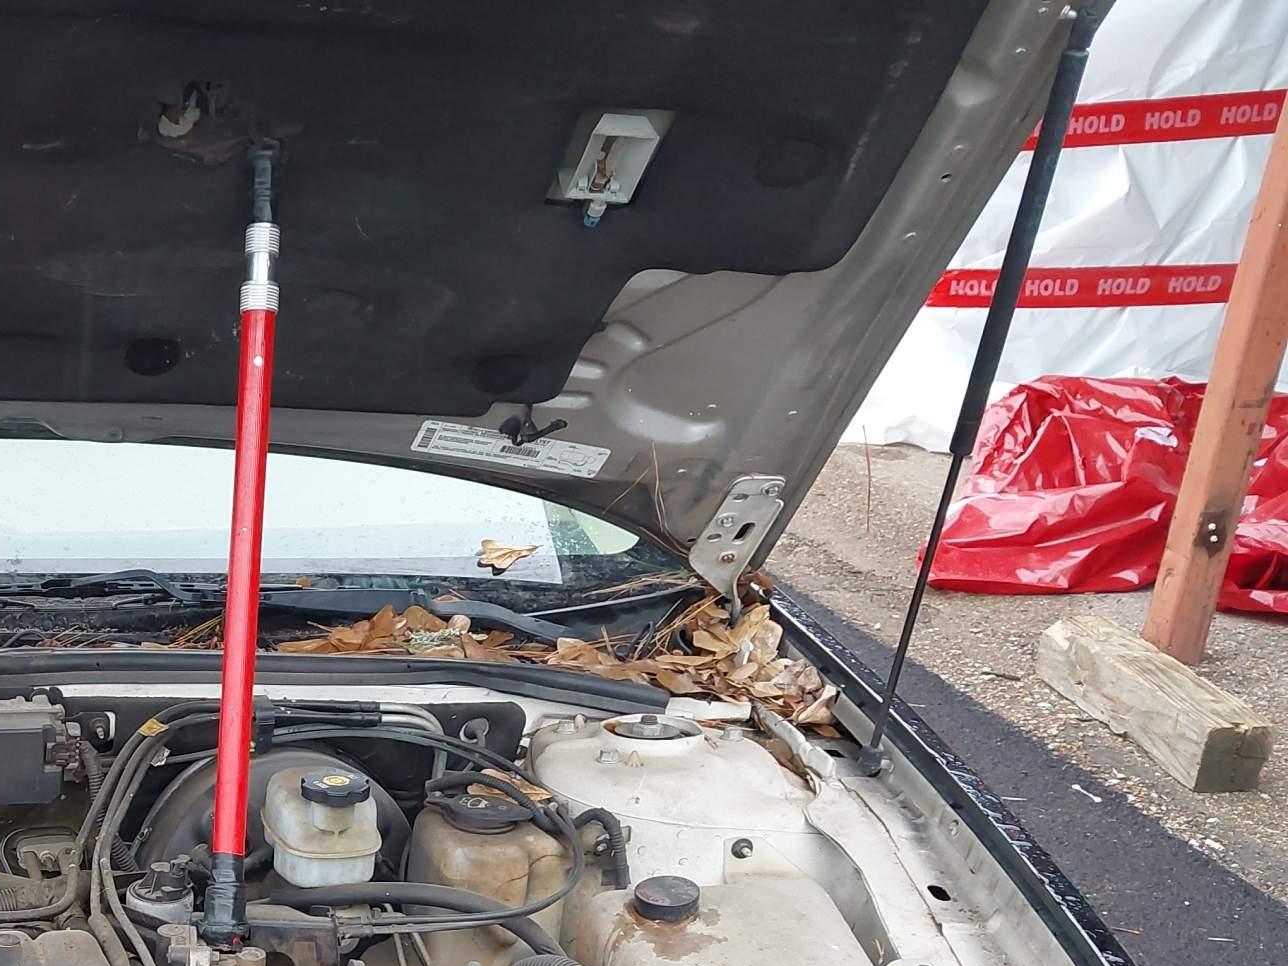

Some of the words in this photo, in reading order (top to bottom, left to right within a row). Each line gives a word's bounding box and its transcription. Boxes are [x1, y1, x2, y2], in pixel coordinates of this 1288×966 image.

[1068, 114, 1125, 134] HOLD
[1145, 109, 1201, 129] HOLD
[1220, 102, 1278, 125] HOLD
[1025, 278, 1079, 297] HOLD
[1097, 276, 1151, 296] HOLD
[1168, 275, 1223, 293] HOLD
